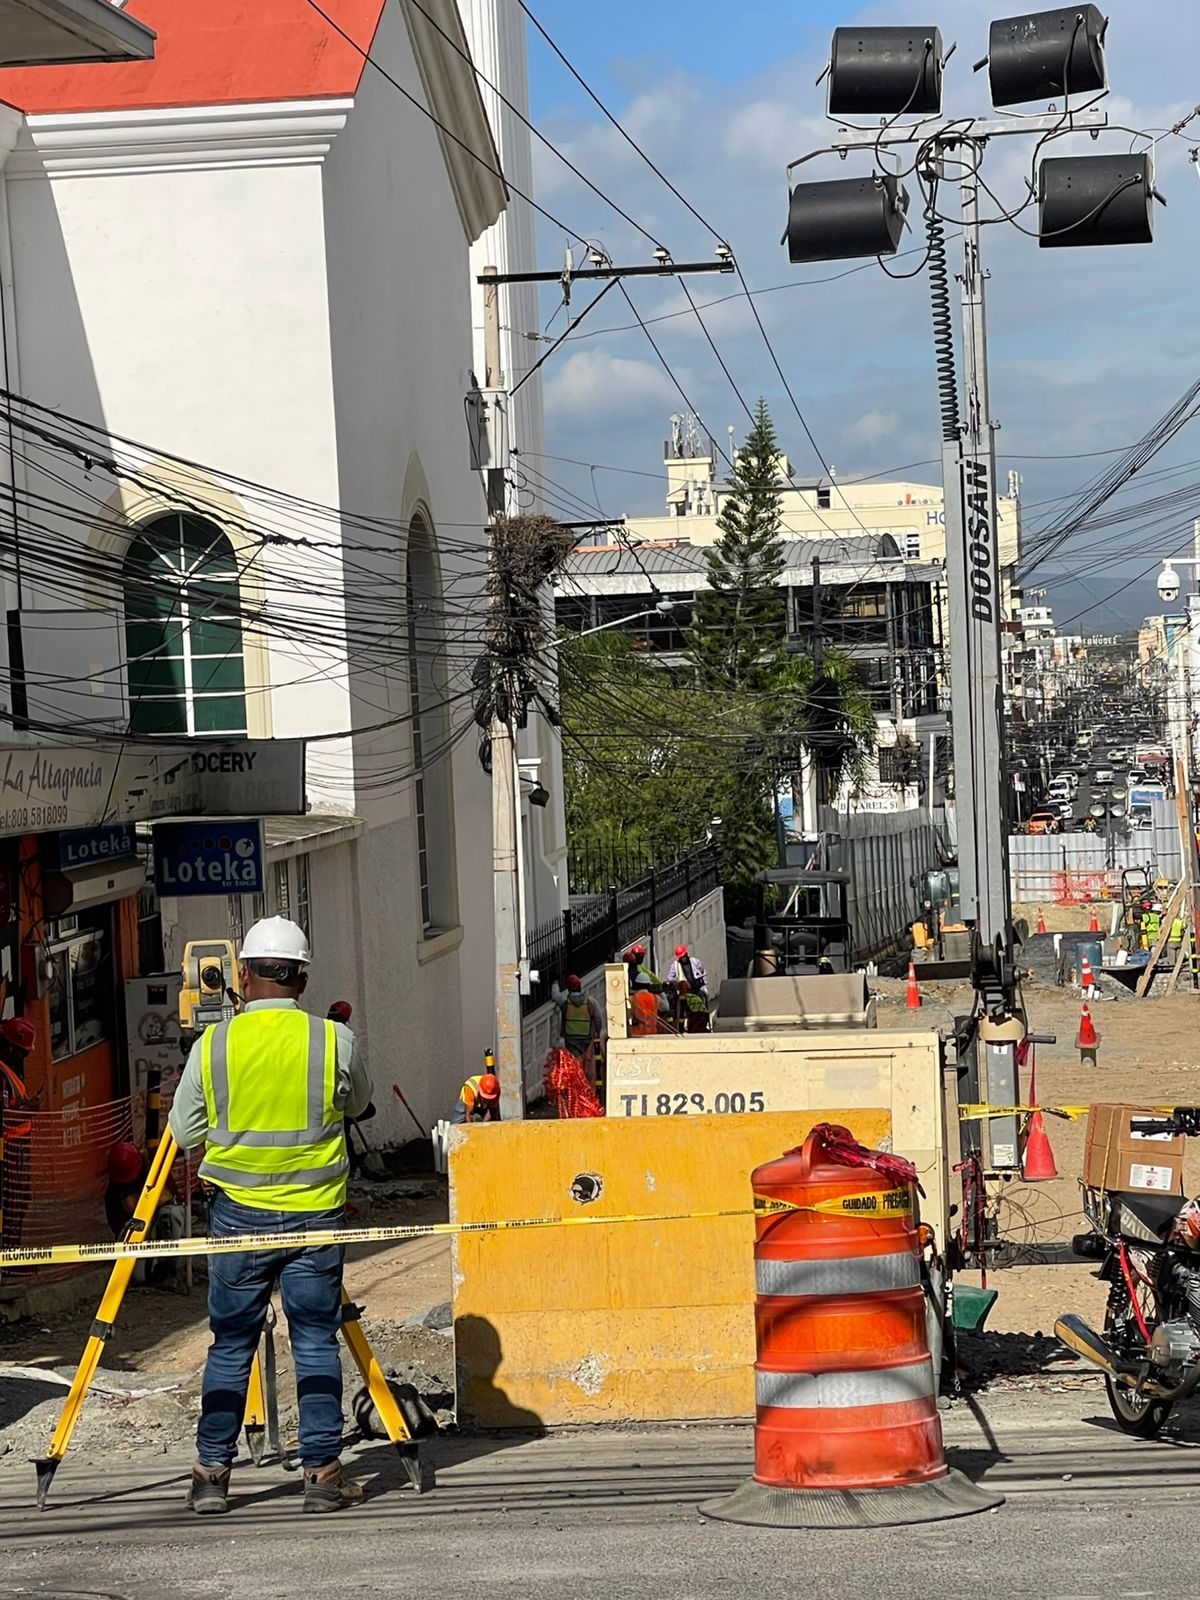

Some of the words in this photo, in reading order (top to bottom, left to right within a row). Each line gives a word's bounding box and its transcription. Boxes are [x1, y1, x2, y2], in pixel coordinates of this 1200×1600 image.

[965, 459, 992, 624] DOOSAN
[2, 751, 24, 793] La
[26, 751, 102, 801] Altagracia
[30, 804, 68, 826] 5818099
[67, 833, 131, 861] Loteka
[163, 853, 257, 883] Loteka
[235, 879, 257, 887] toca
